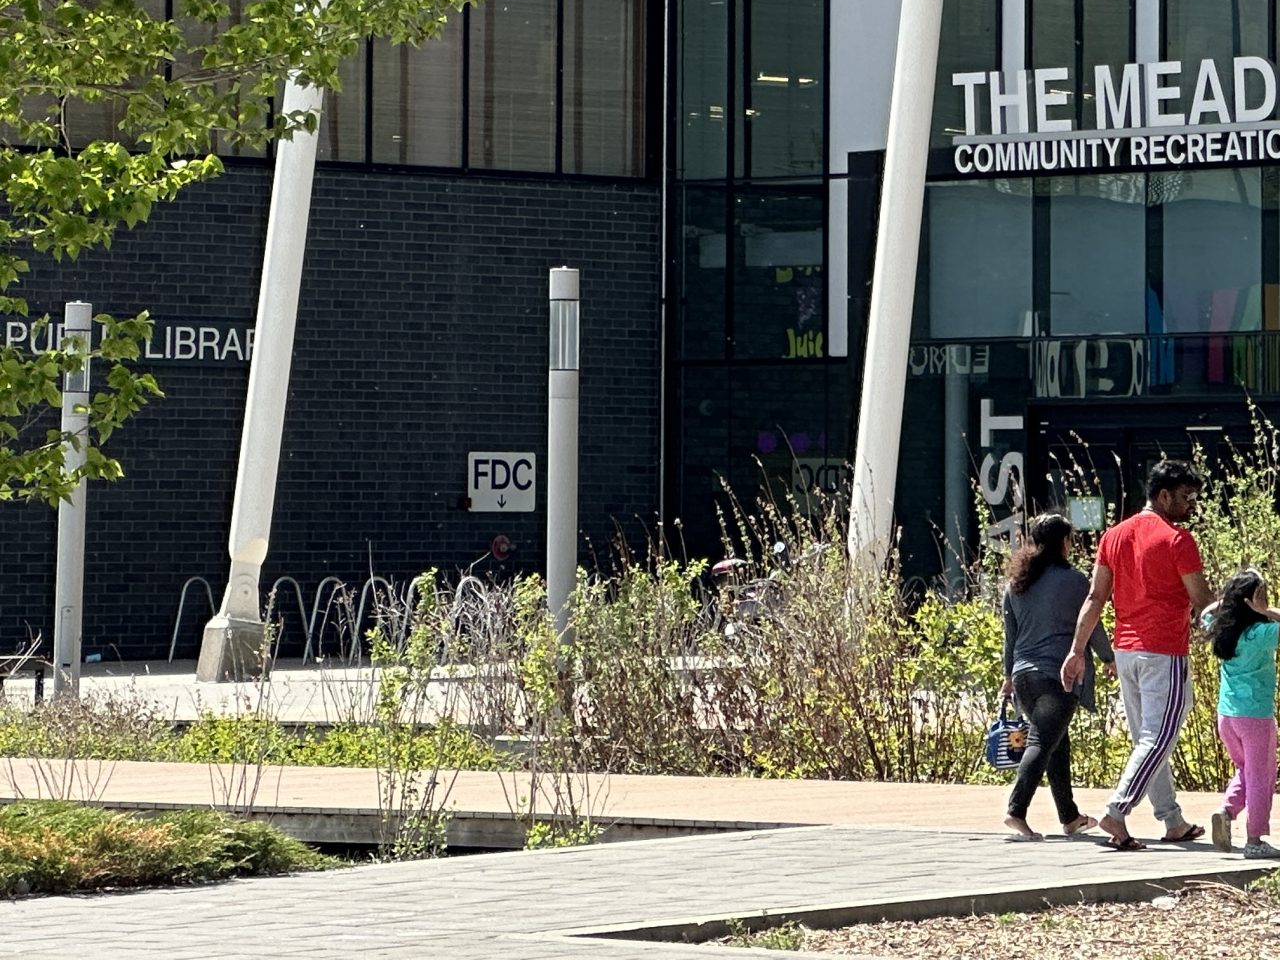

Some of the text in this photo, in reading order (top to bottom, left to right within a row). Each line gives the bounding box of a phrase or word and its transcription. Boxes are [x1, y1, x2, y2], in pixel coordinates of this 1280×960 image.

[952, 66, 1074, 136] THE
[953, 138, 1121, 174] COMMUNITY
[474, 459, 532, 491] FDC
[980, 398, 1024, 554] AST
